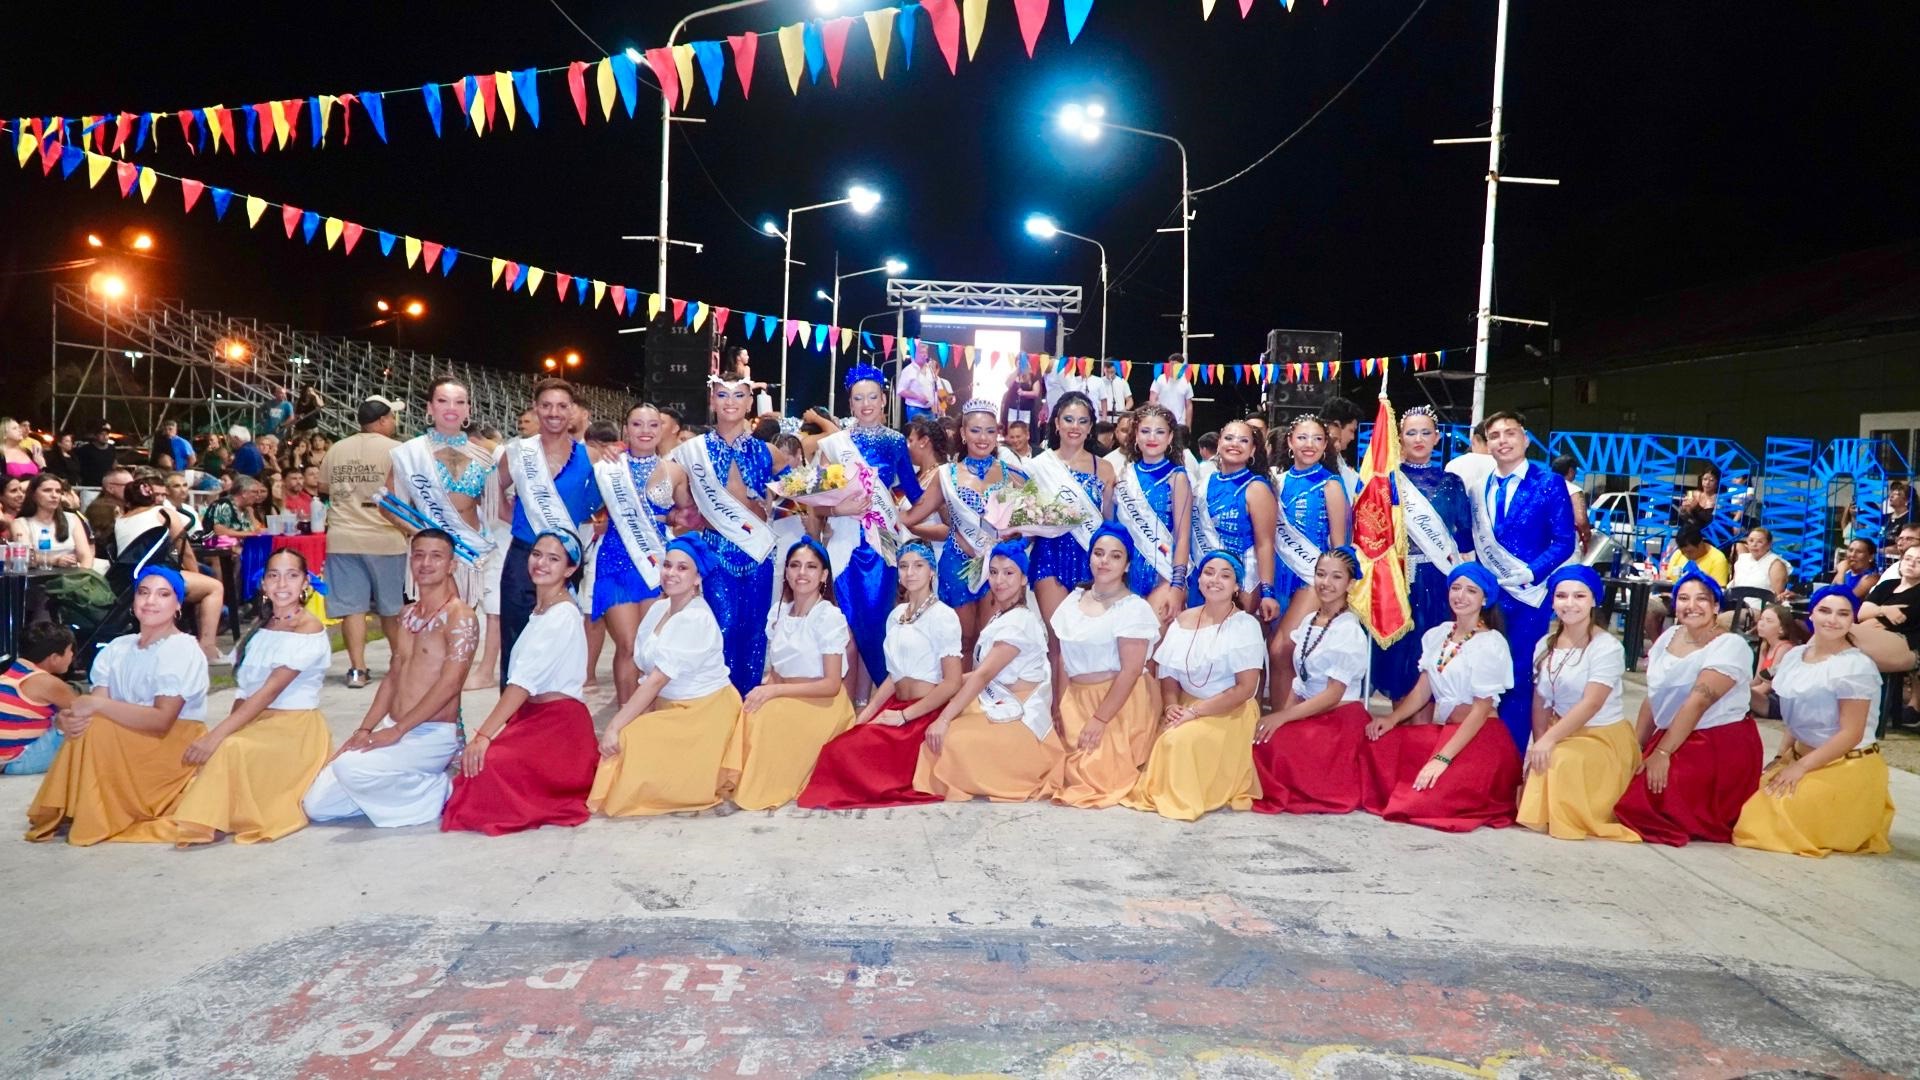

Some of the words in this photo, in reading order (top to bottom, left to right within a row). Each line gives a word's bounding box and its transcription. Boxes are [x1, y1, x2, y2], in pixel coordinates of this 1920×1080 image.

[671, 326, 688, 334] STS
[1297, 345, 1316, 354] STS
[669, 364, 688, 372] STS
[1296, 383, 1315, 392] STS
[692, 463, 742, 521] Destaque
[530, 484, 561, 528] Masculin
[1116, 480, 1160, 543] Cordoneras
[1413, 514, 1445, 551] Bandera
